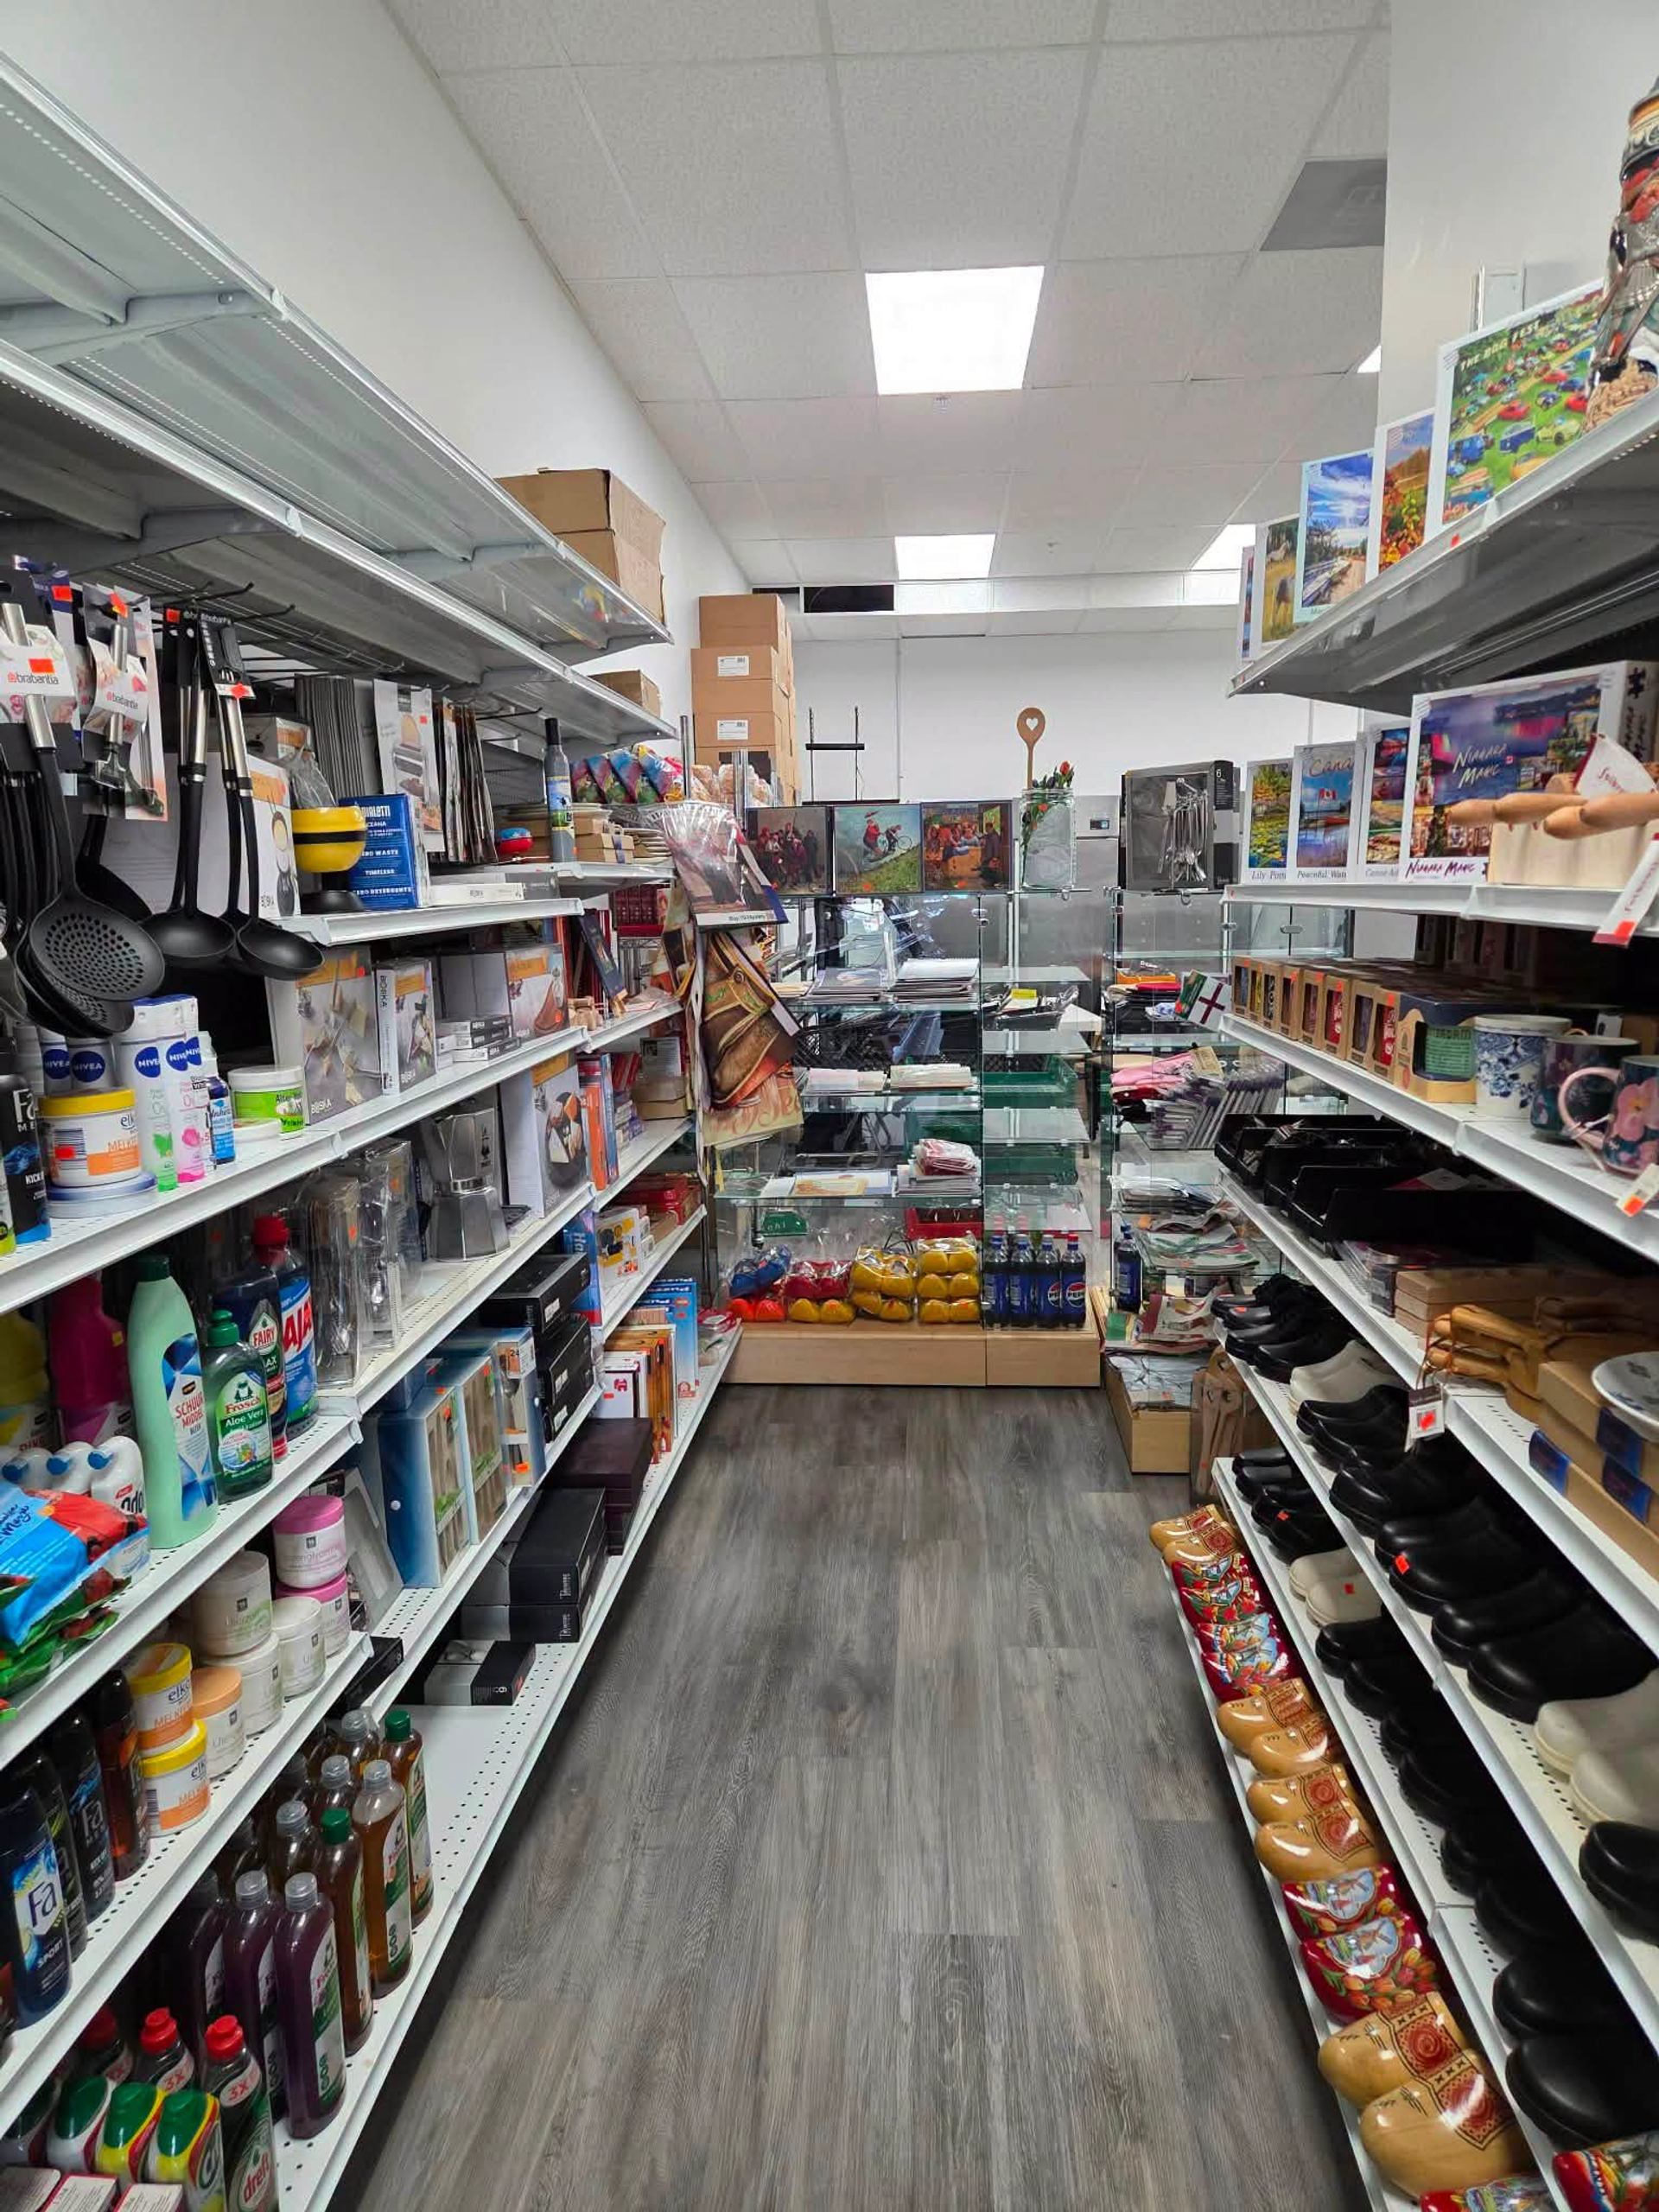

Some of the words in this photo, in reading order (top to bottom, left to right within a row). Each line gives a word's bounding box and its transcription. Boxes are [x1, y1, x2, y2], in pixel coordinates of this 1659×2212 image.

[16, 672, 60, 685] brabantia
[1309, 753, 1355, 778] Cana
[1252, 870, 1266, 880] Lily
[378, 974, 387, 1008] BOSKA
[311, 1097, 332, 1114] BOSKA
[252, 1327, 275, 1346] FAIRY
[226, 1416, 245, 1428] Aloe
[29, 1881, 57, 1929] Fa
[228, 2082, 250, 2105] 3X
